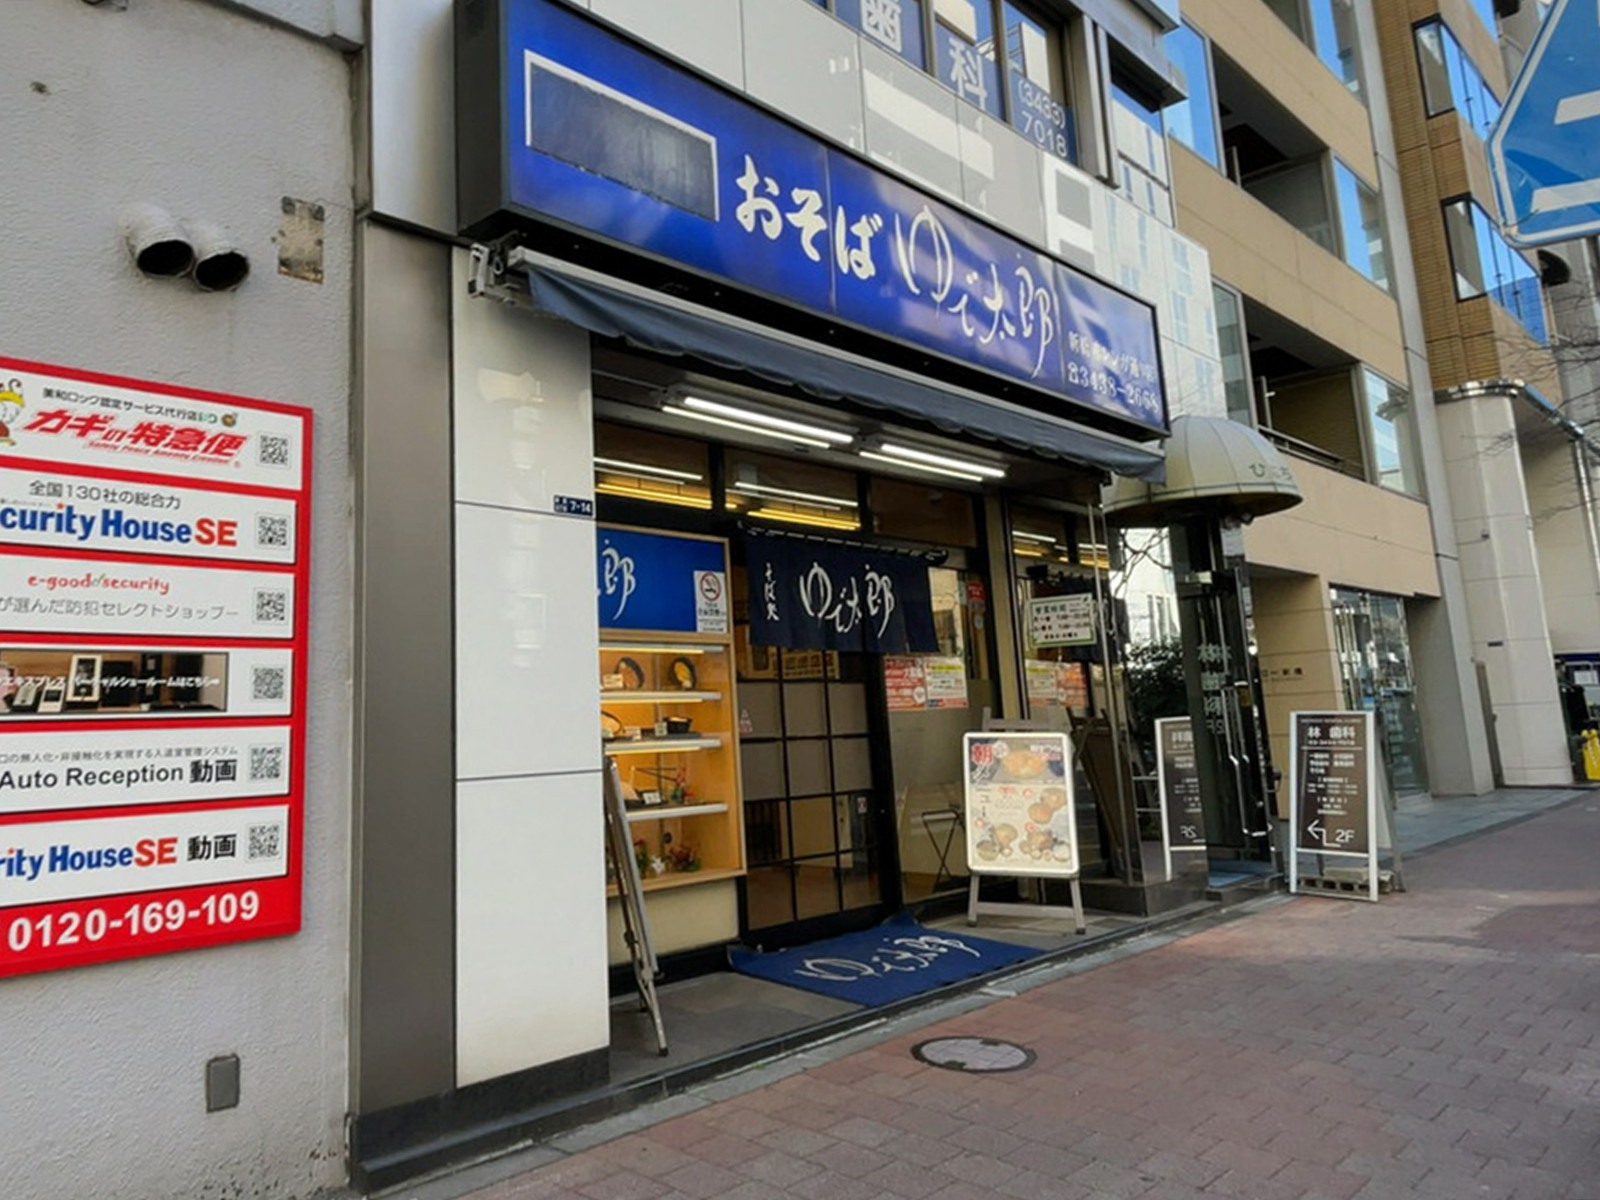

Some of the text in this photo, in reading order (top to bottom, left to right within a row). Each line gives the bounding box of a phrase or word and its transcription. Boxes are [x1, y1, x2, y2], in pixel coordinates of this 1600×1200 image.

[1021, 111, 1068, 157] 7018
[735, 154, 1054, 379] おそば ゆで太郎
[23, 409, 247, 457] カギの特急便
[29, 480, 181, 510] 全国130社の総合力
[0, 502, 96, 541] curity
[102, 573, 170, 596] security
[800, 562, 895, 639] ゆで太郎
[0, 759, 238, 790] Auto Reception 動画
[187, 834, 237, 862] 動画
[1335, 829, 1355, 843] 2F
[7, 890, 260, 951] 0120-169-109
[794, 935, 981, 981] ゆで太郎
